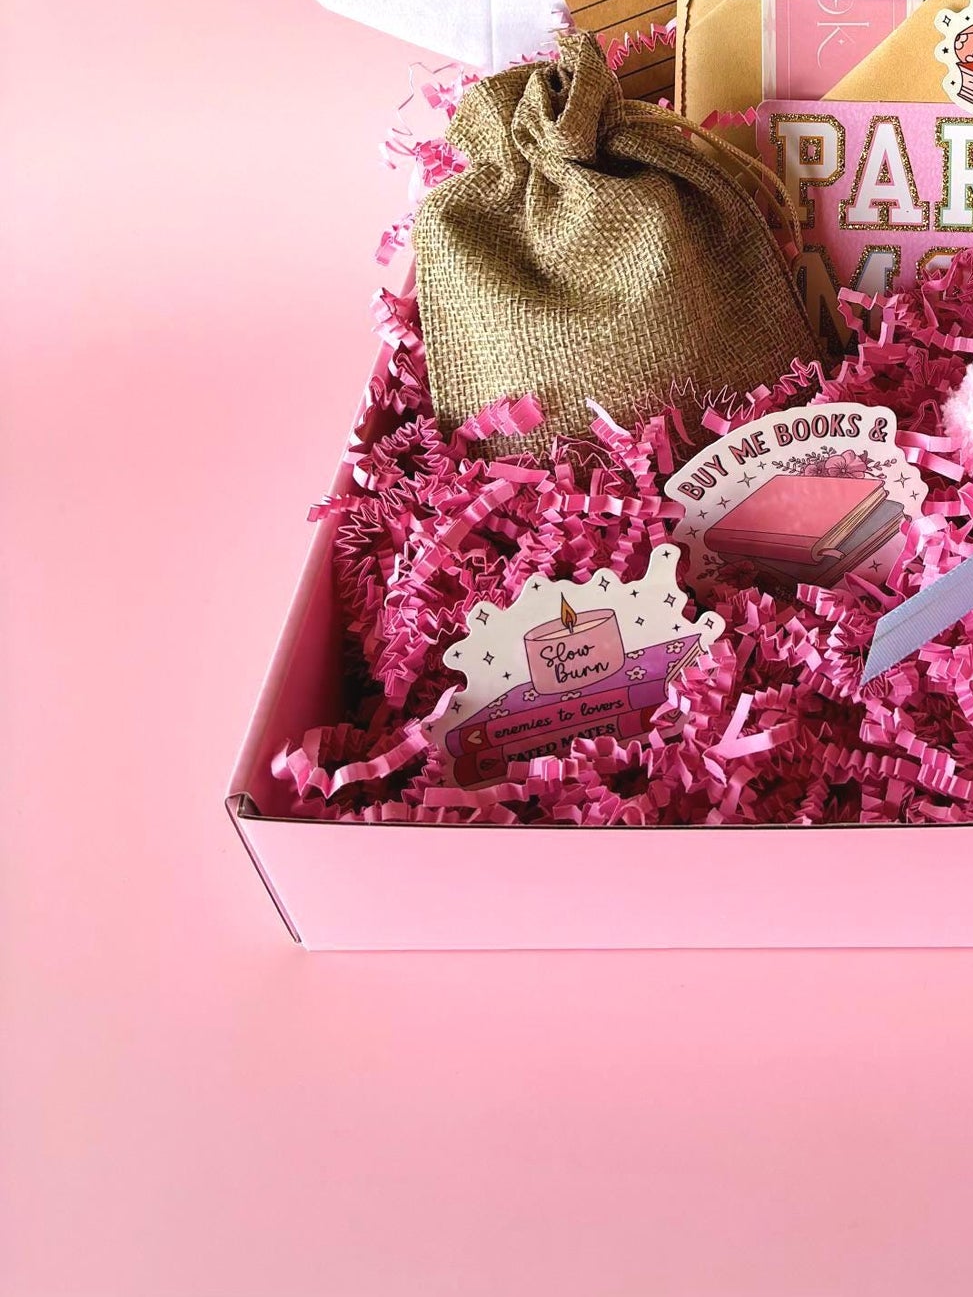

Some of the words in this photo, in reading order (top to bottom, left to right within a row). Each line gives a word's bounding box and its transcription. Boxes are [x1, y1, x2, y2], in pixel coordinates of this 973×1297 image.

[677, 454, 729, 501] BUY
[728, 430, 771, 466] ME
[773, 413, 863, 447] BOOKS
[868, 417, 889, 443] &
[539, 641, 595, 668] Slow
[554, 661, 610, 684] Burn
[494, 716, 553, 738] enemies
[557, 707, 575, 722] to
[580, 699, 625, 717] lovers
